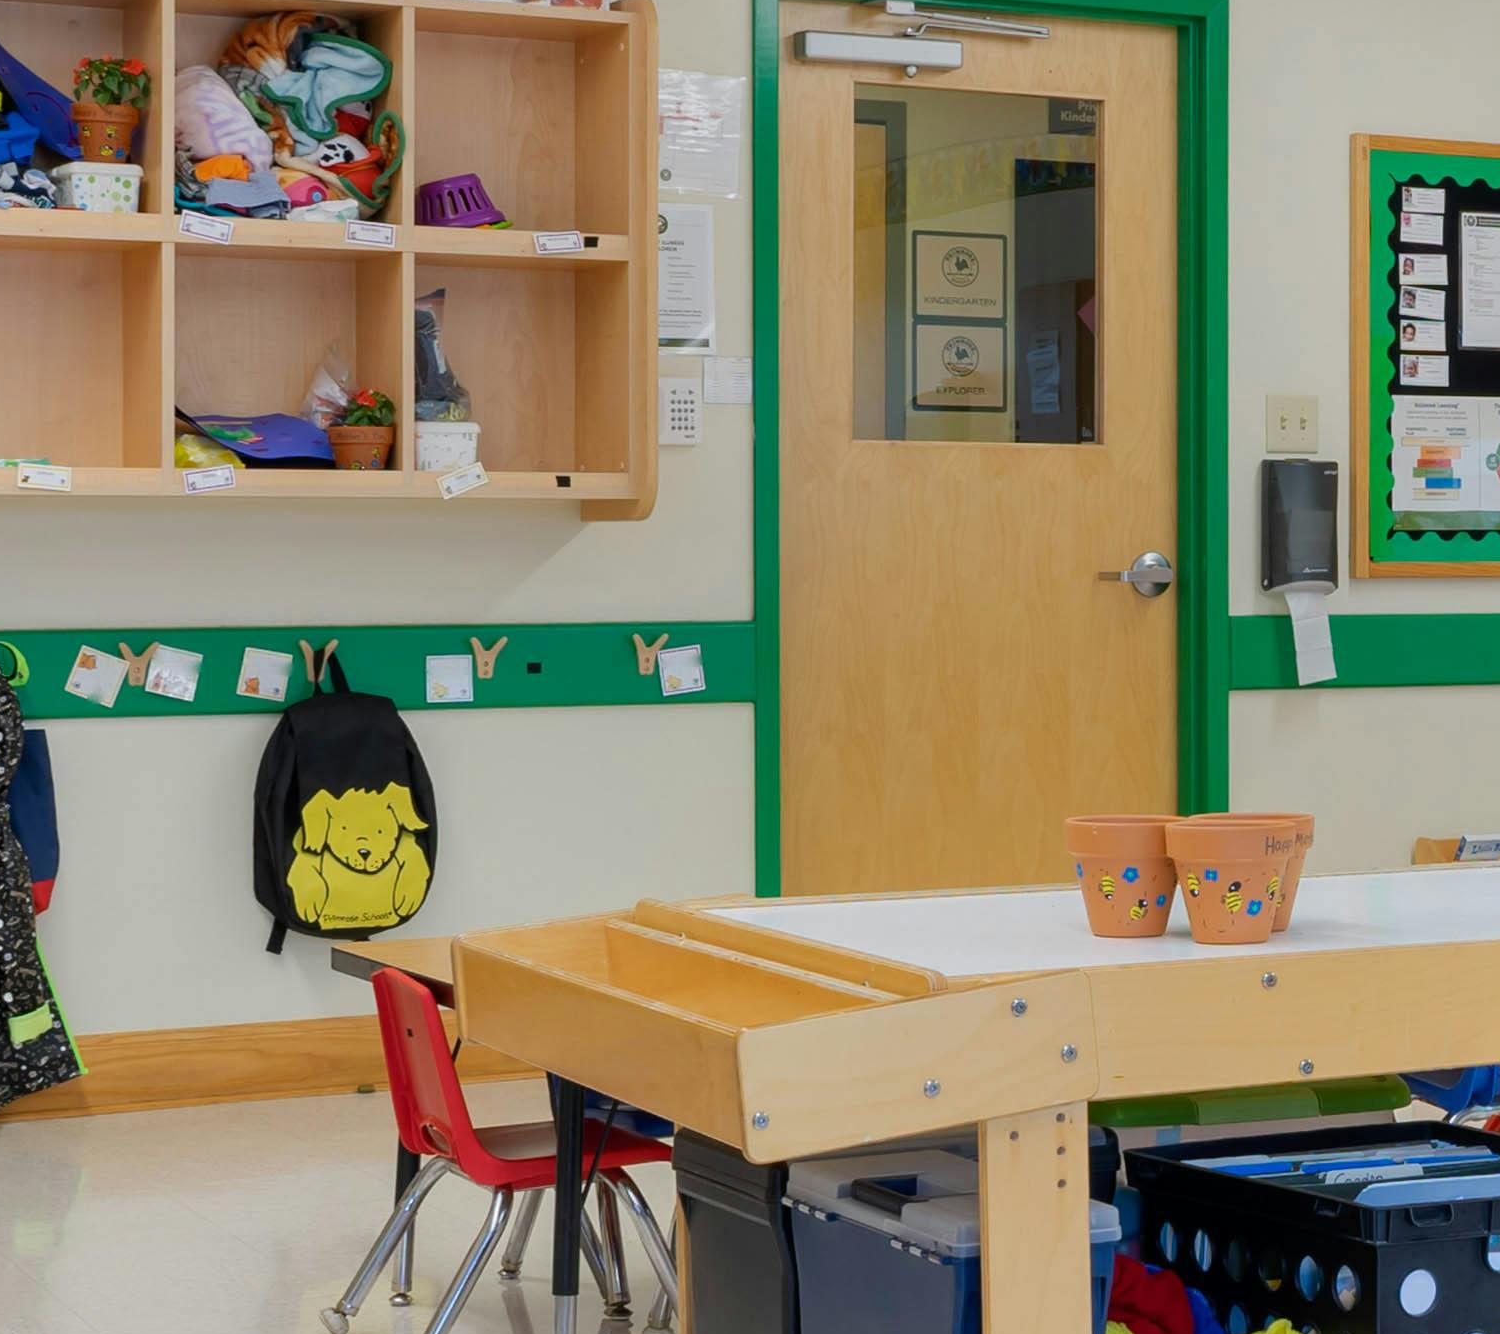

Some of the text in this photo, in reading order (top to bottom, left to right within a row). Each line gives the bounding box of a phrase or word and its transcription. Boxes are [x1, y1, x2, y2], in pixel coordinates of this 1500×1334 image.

[924, 296, 997, 307] KINDERGARTEN
[936, 386, 987, 397] EXPLORER
[323, 914, 359, 923] Primrose
